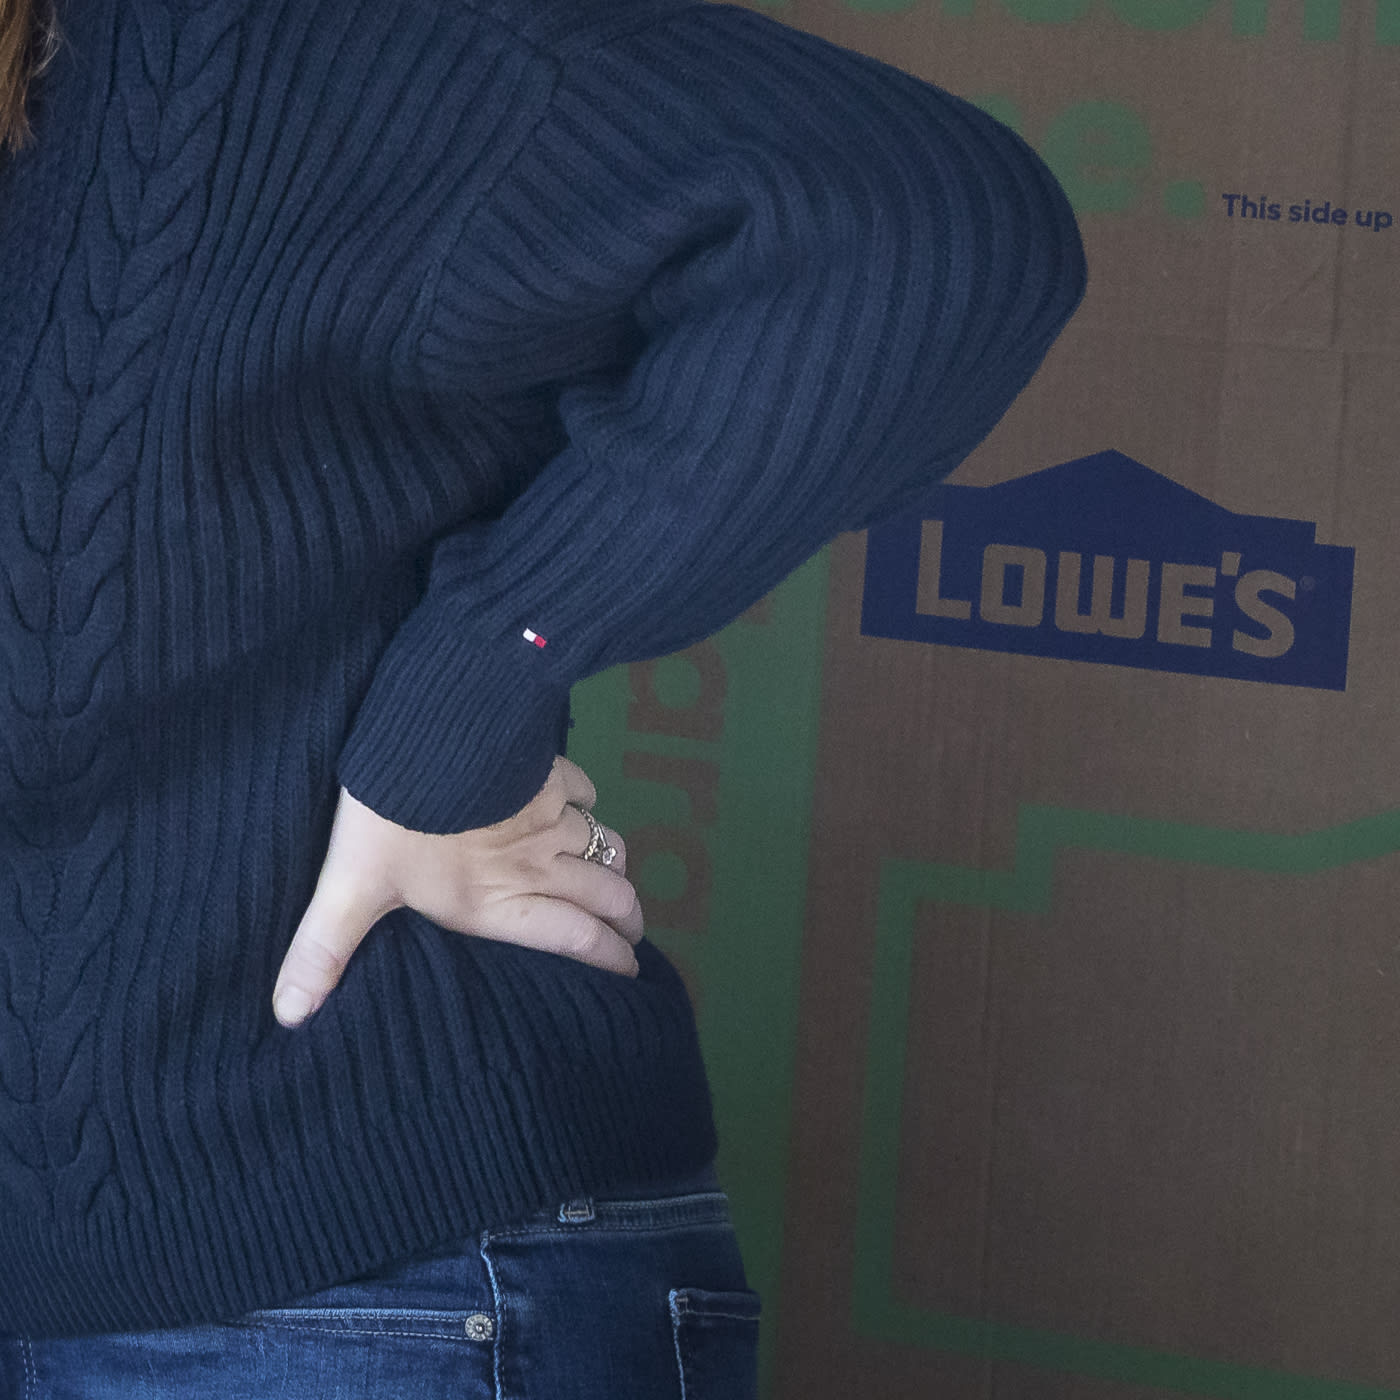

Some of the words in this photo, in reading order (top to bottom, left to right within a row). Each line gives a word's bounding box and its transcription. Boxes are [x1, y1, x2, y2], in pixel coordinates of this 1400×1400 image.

[1222, 193, 1281, 221] This
[1289, 199, 1348, 225] side
[1355, 209, 1393, 232] up
[915, 519, 1297, 659] LOWE'S
